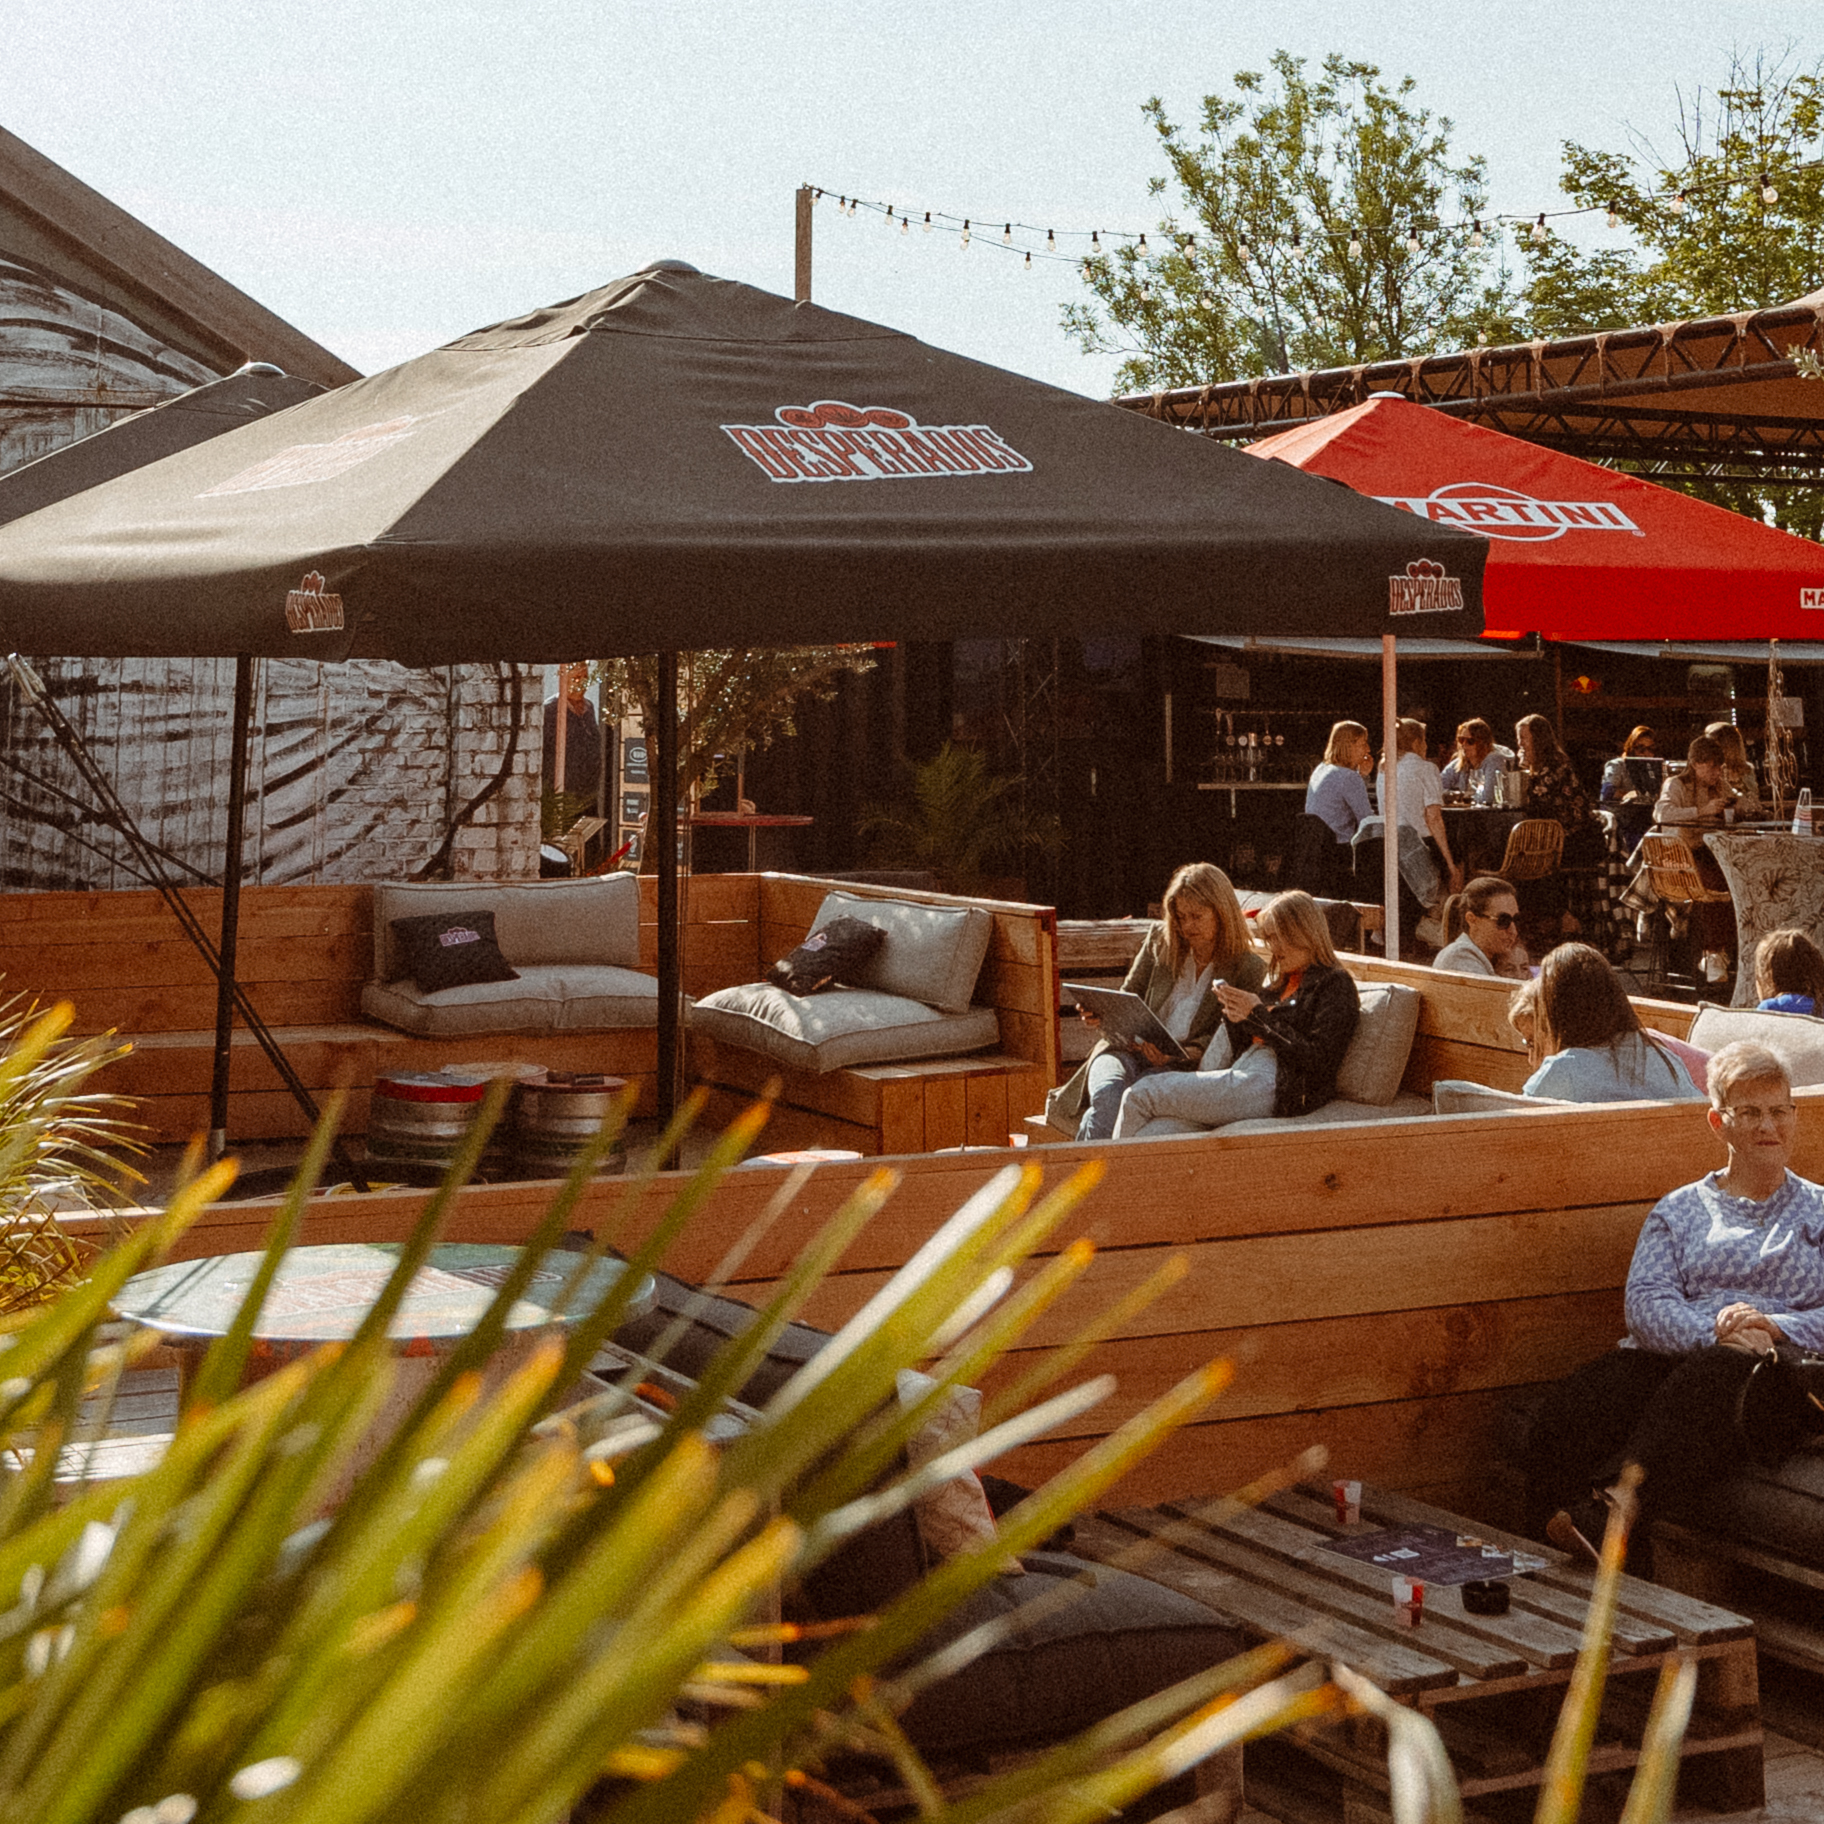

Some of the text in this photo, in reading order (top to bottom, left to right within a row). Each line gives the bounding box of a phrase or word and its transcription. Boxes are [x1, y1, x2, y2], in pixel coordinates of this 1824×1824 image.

[722, 425, 1033, 480] DESPERADOS
[1394, 500, 1623, 527] ARTINI
[1389, 576, 1463, 614] DESPERADOS
